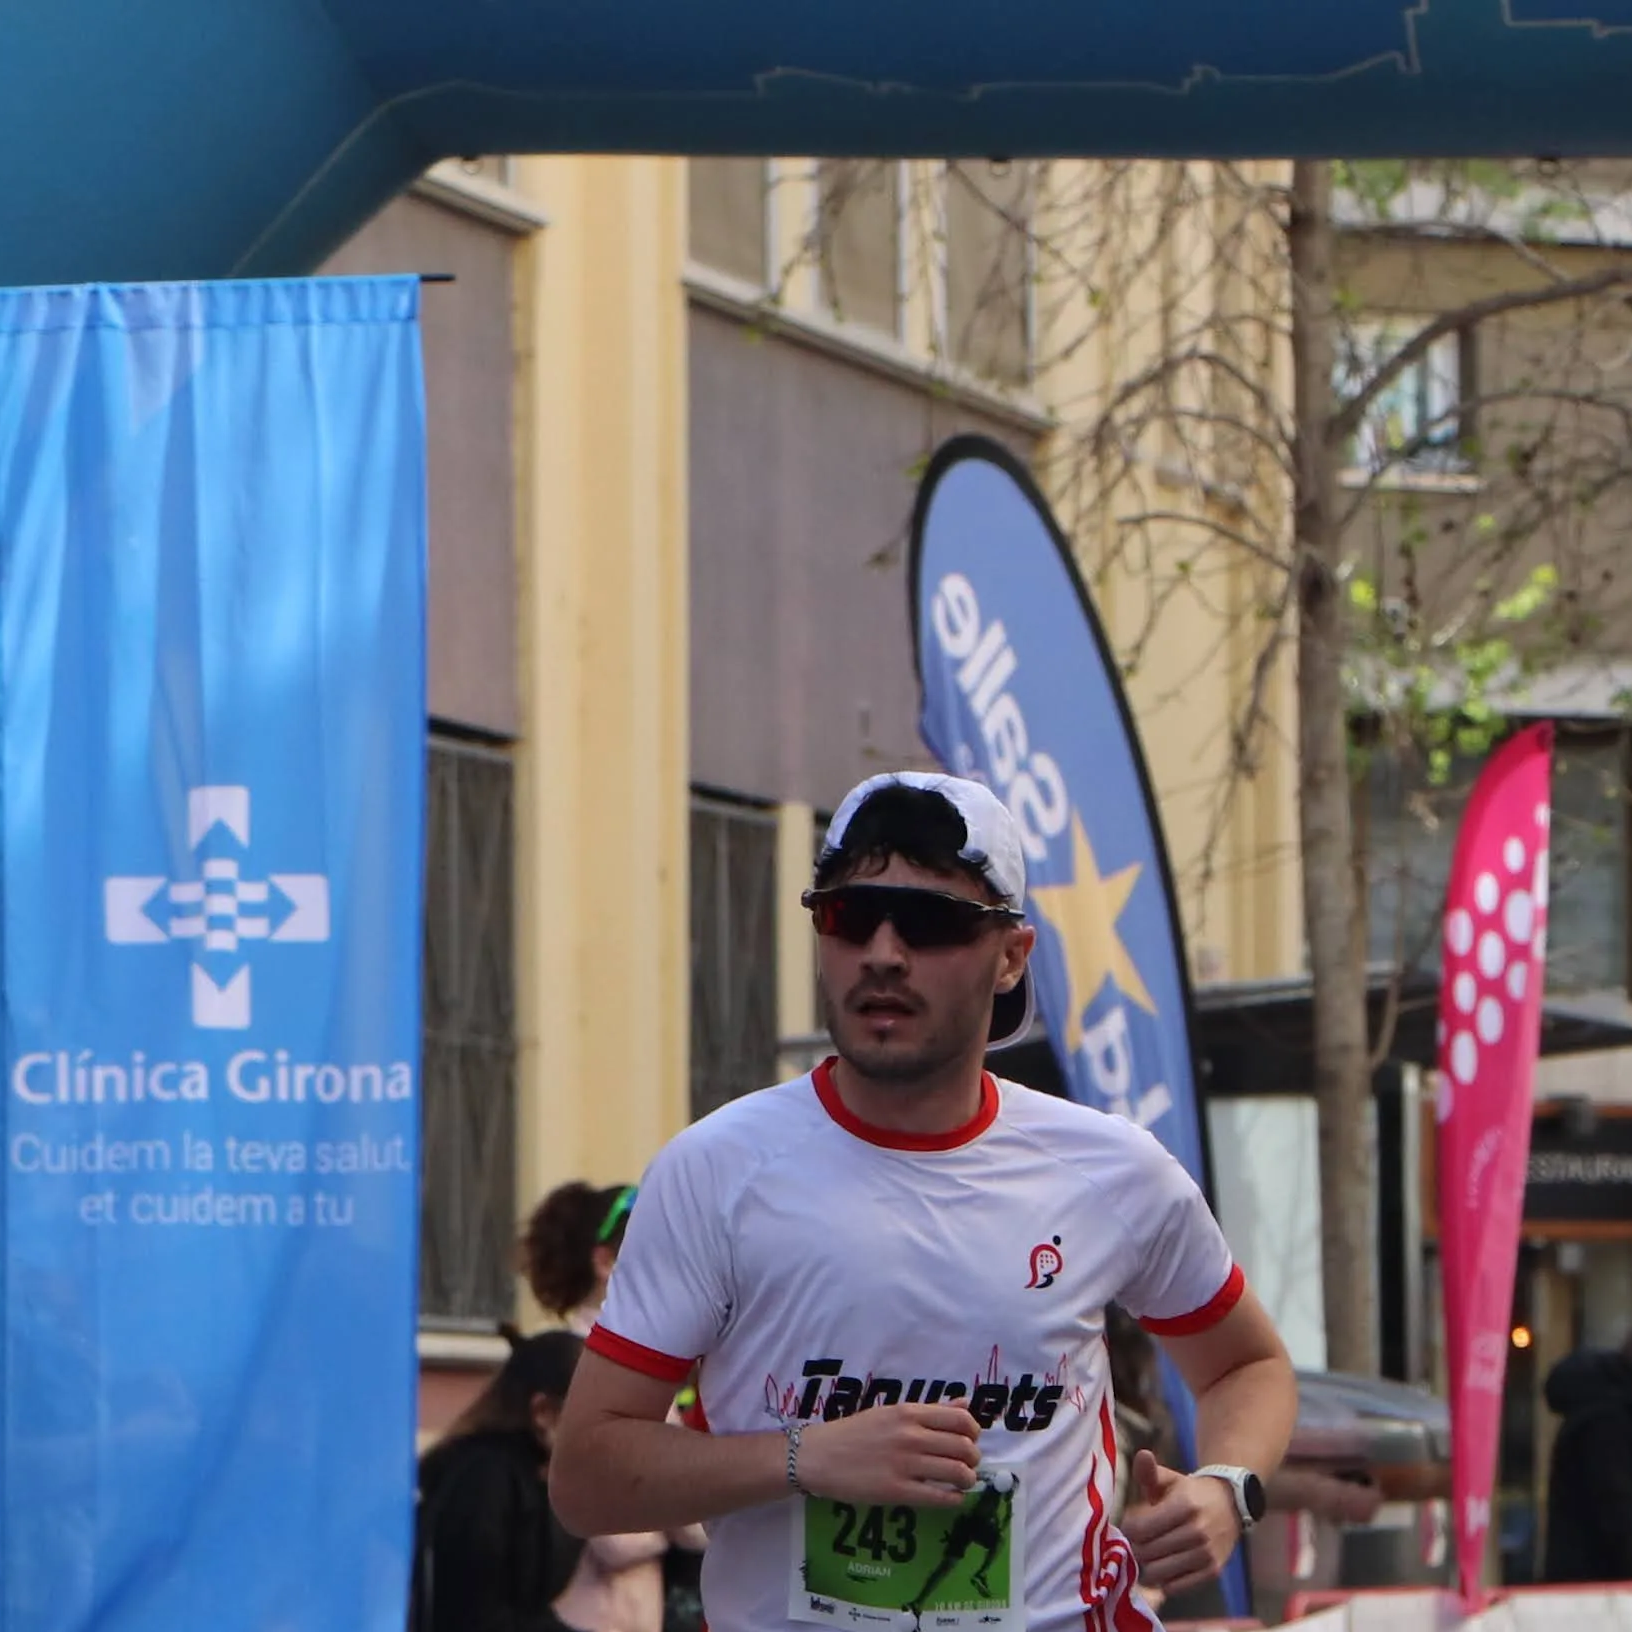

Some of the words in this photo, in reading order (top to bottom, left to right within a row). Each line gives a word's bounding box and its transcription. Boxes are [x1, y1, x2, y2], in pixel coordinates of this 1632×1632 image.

[11, 1048, 210, 1104] Clínica
[227, 1048, 413, 1104] Girona
[9, 1131, 172, 1174] Cuidem
[182, 1130, 214, 1172] la
[226, 1135, 306, 1175] teva
[79, 1190, 117, 1226] et
[130, 1183, 278, 1227] cuidem
[285, 1197, 305, 1227] a
[314, 1192, 356, 1228] tu
[832, 1502, 916, 1563] 243
[848, 1561, 891, 1578] ADRIAN
